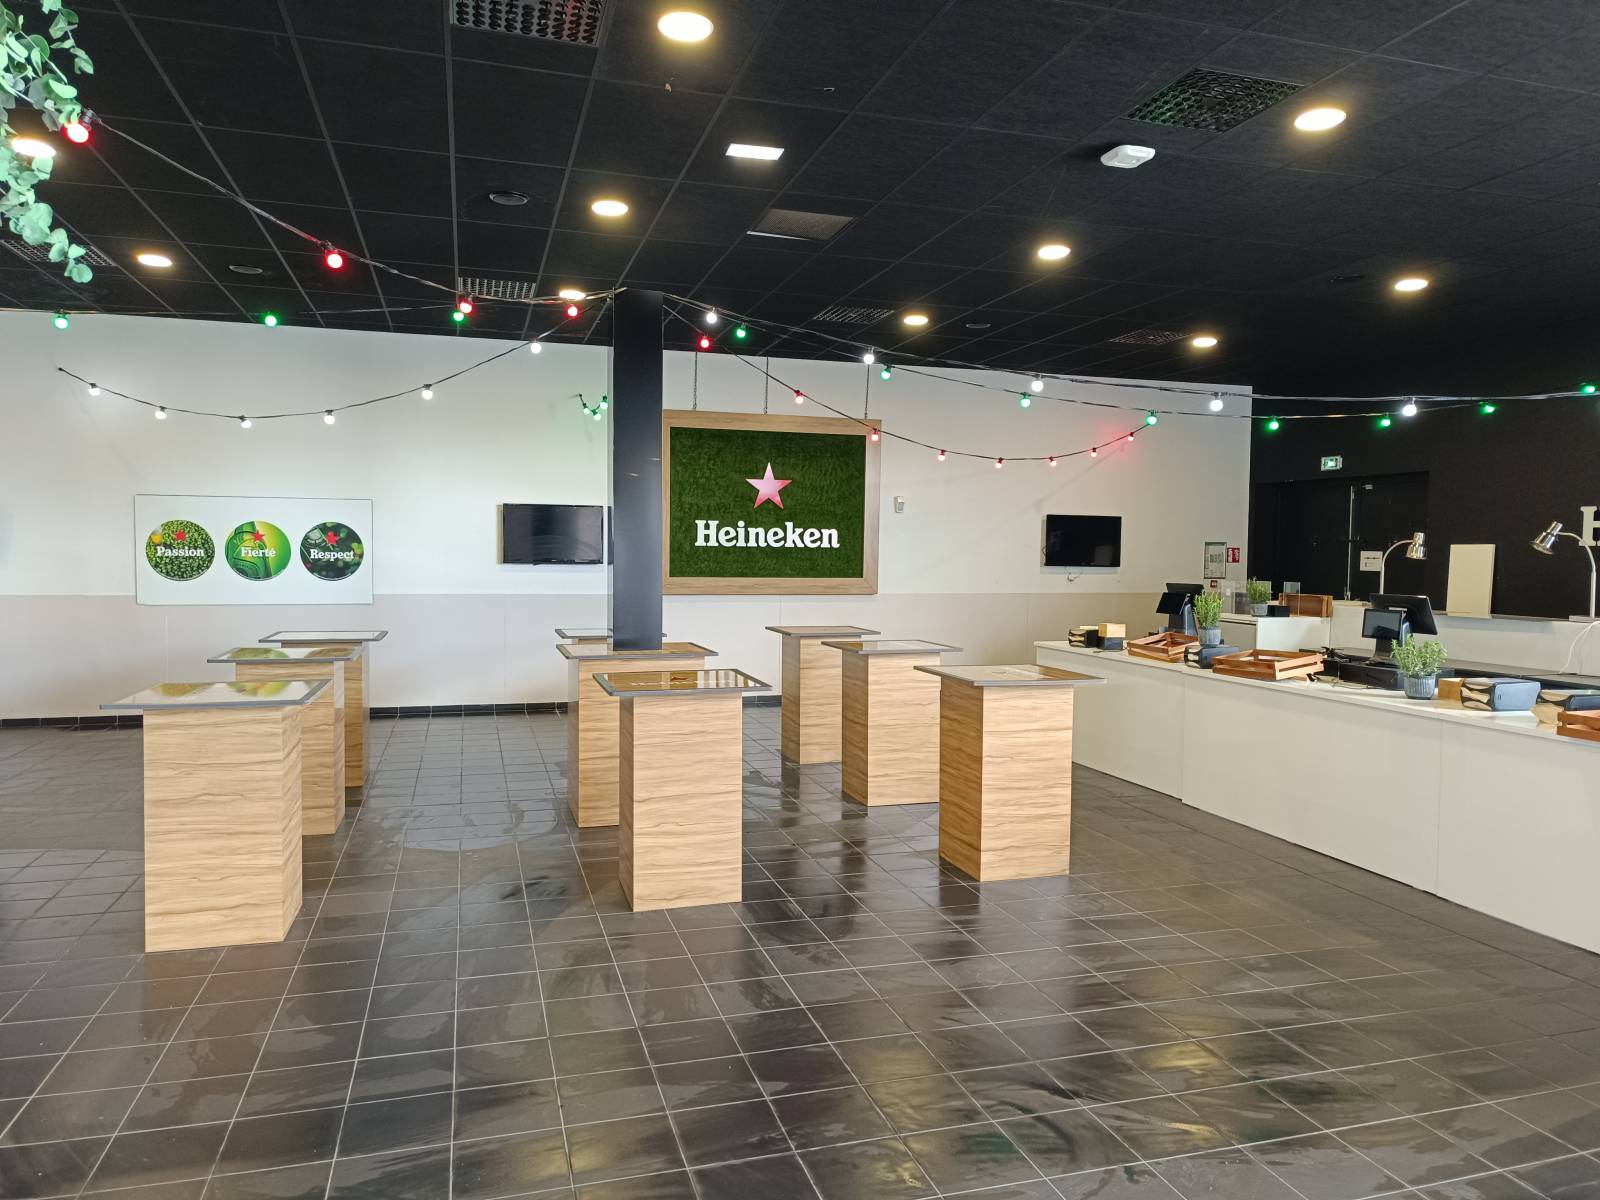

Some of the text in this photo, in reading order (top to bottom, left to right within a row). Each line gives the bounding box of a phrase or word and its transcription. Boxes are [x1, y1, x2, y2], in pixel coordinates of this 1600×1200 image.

[695, 520, 840, 549] Heineken
[156, 546, 205, 557] Passion
[240, 546, 277, 558] Fierté
[310, 548, 355, 562] Respect
